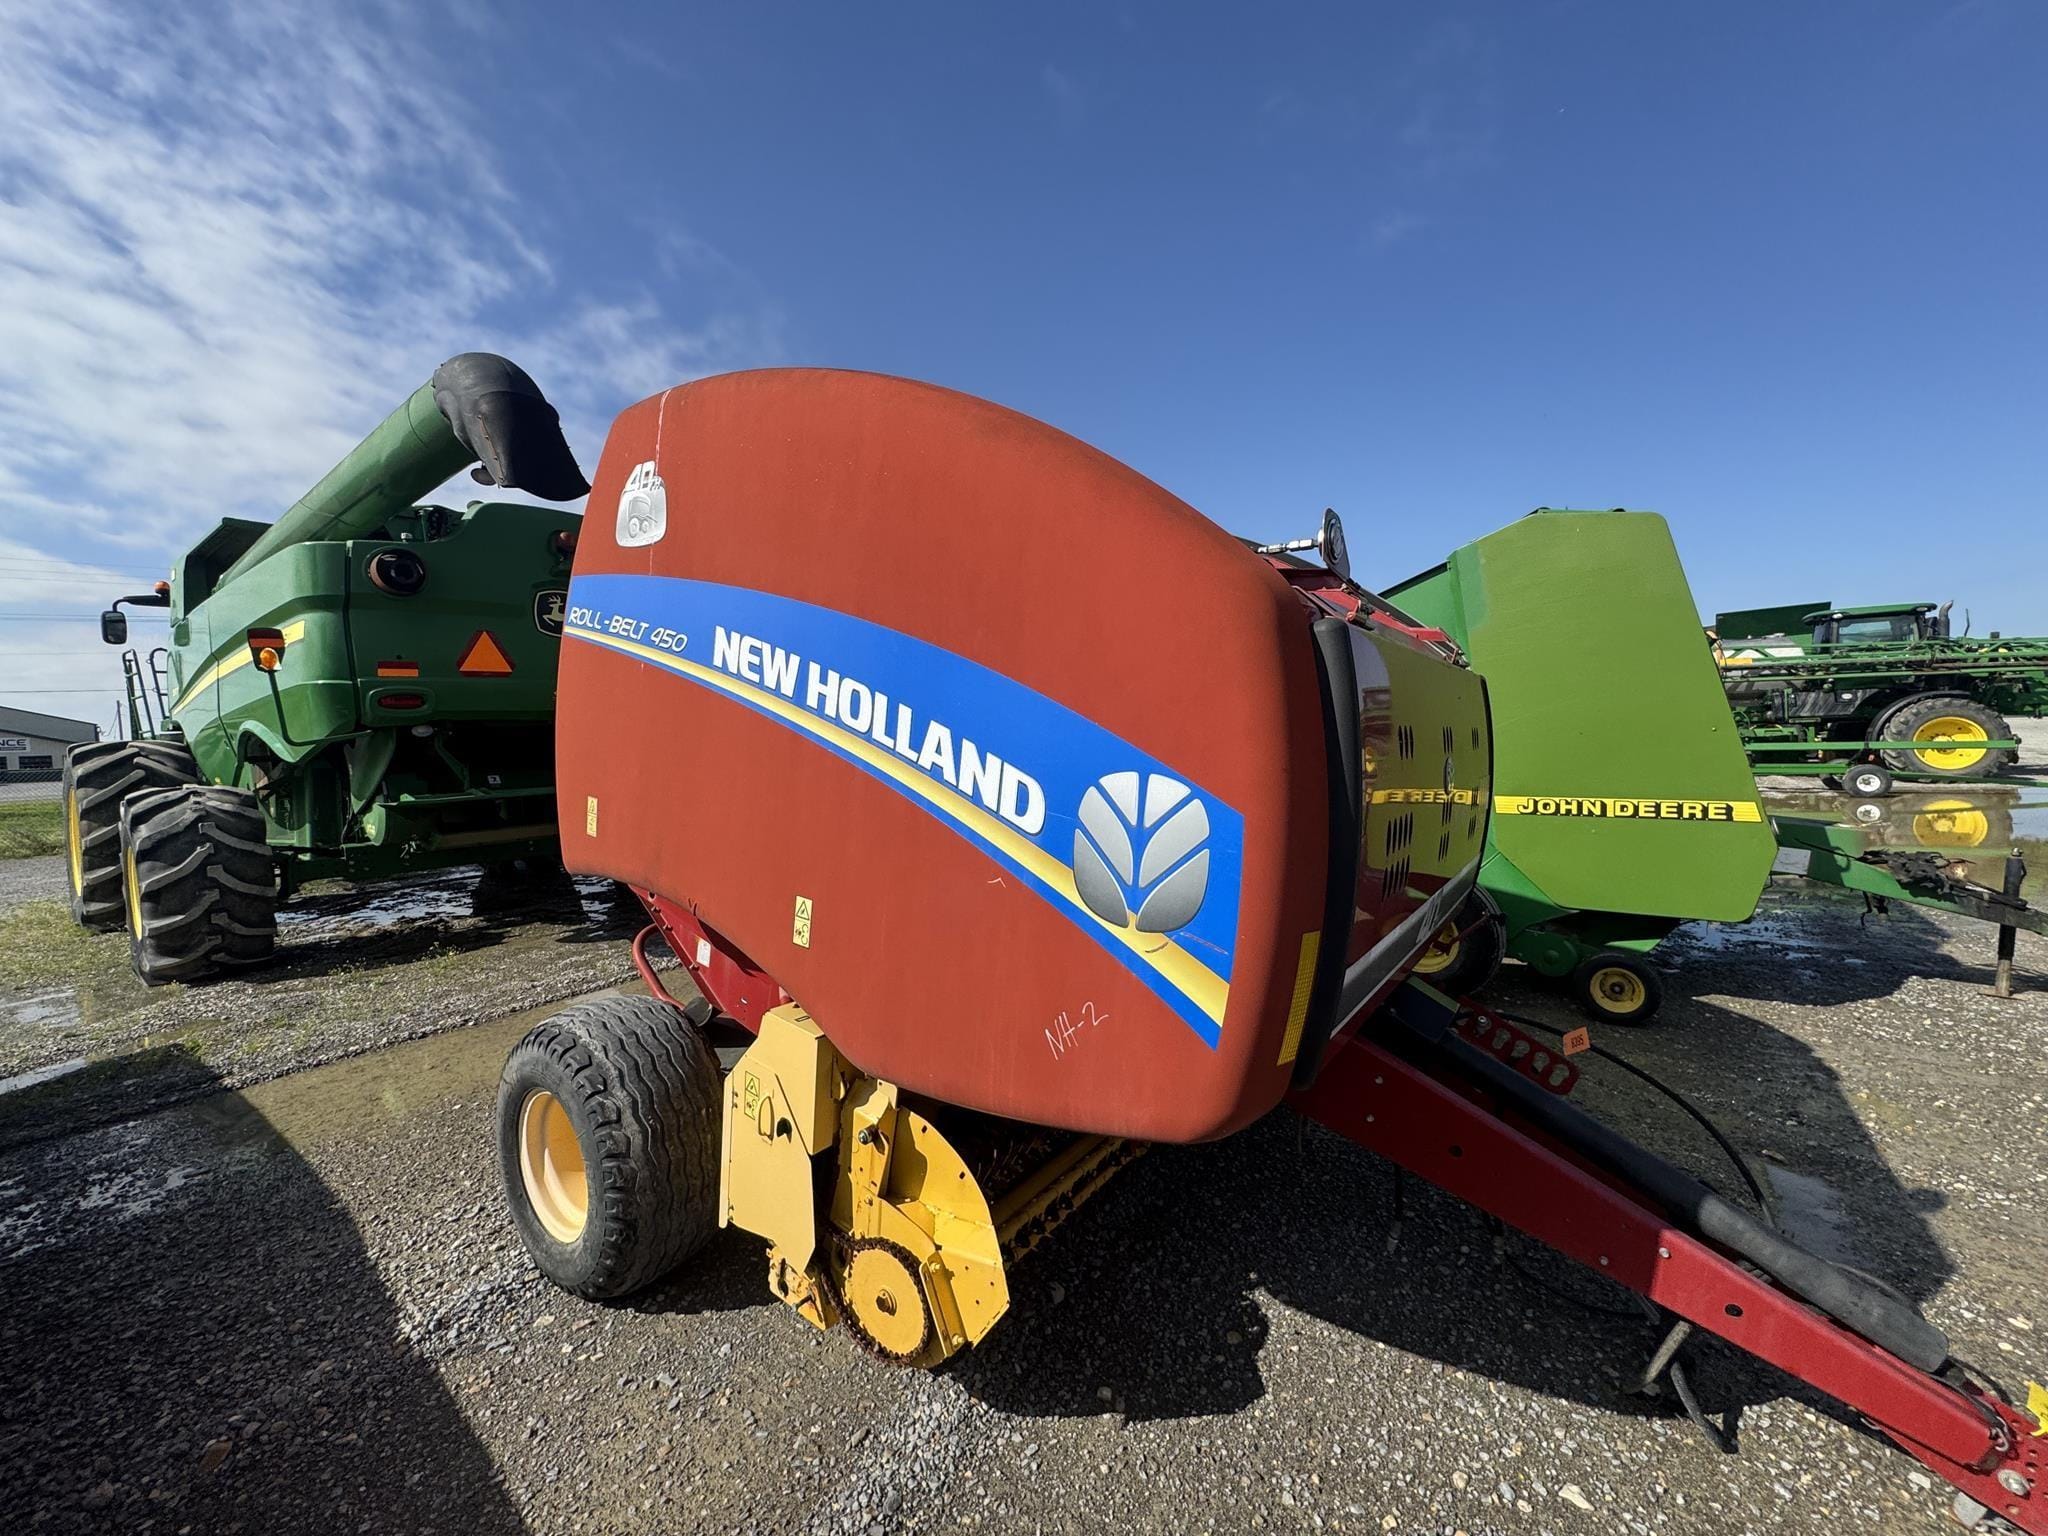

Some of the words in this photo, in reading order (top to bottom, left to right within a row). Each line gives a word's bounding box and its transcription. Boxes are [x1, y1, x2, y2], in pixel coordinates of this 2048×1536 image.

[568, 607, 649, 640] ROLL-BELT
[650, 628, 688, 652] 450
[713, 625, 800, 698] NEW
[806, 661, 1046, 835] HOLLAND
[1517, 798, 1605, 816] JOHN
[1613, 800, 1734, 820] DEERE
